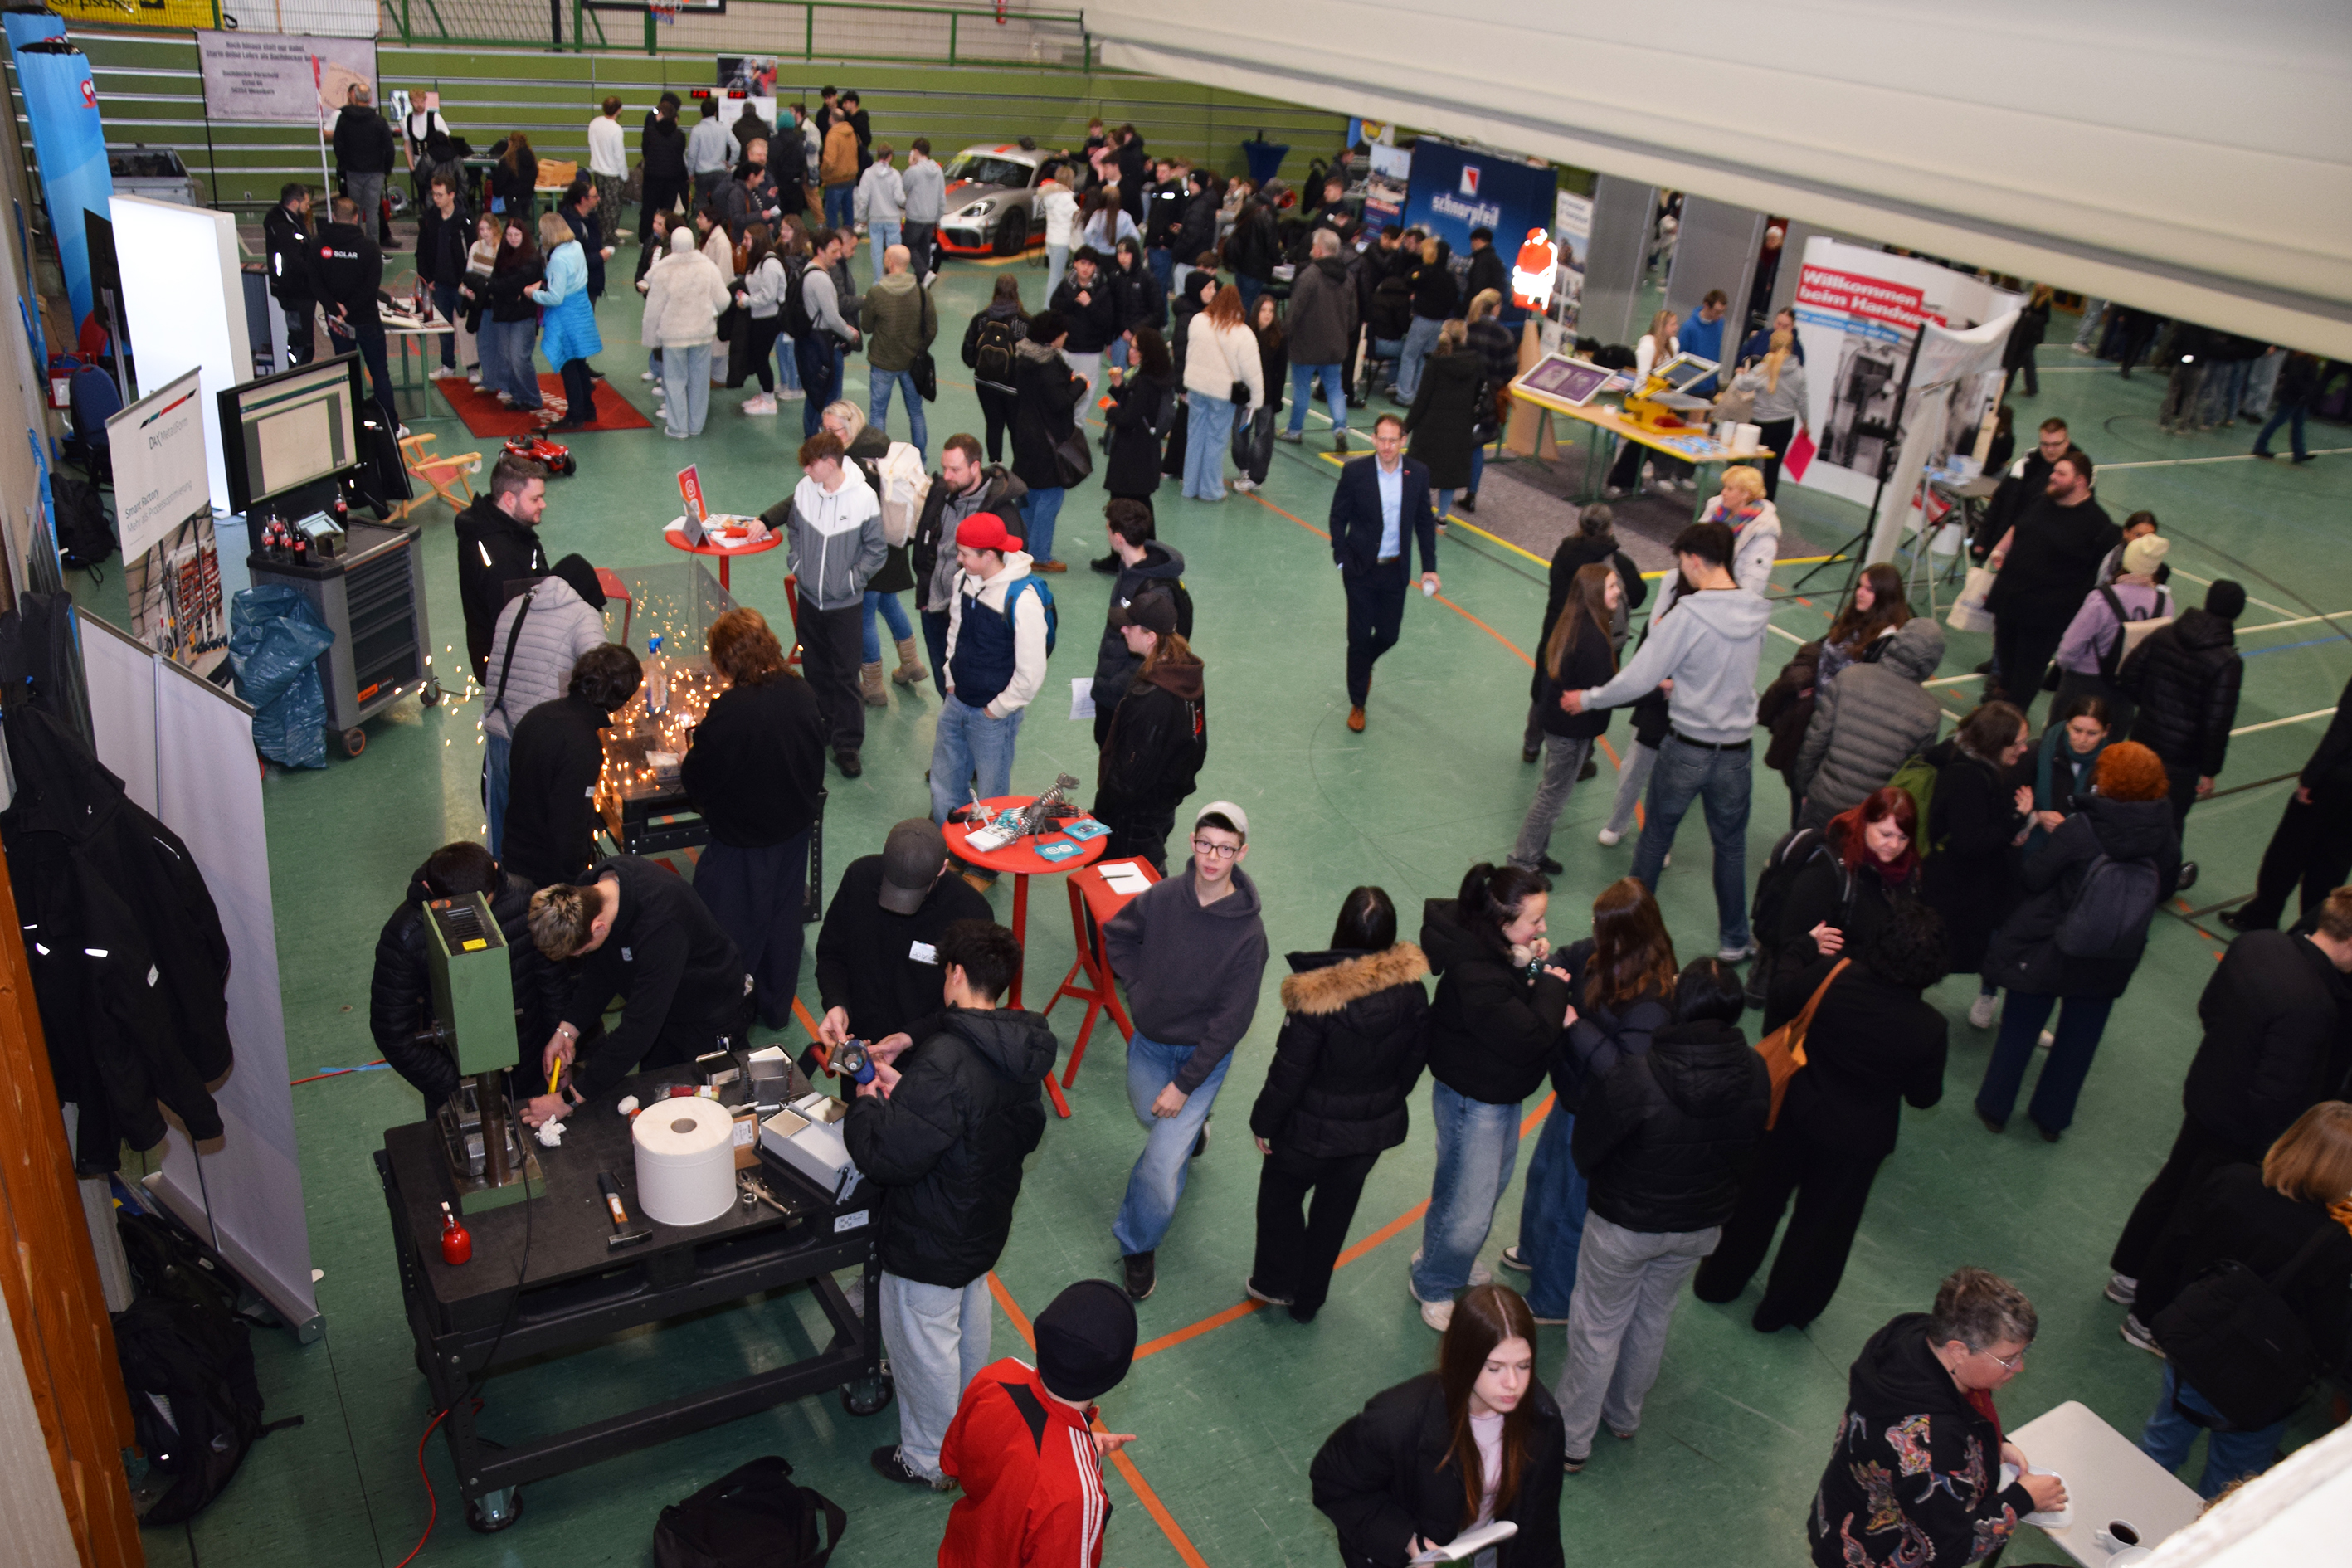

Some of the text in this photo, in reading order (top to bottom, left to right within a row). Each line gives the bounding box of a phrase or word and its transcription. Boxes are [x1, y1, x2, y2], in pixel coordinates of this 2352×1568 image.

[1432, 192, 1500, 227] schnorpfeil
[334, 250, 358, 259] SOLAR
[1799, 285, 1848, 307] beim
[1803, 268, 1918, 306] Willkommen
[125, 488, 159, 519] Smart Factory
[126, 518, 141, 534] Mehr
